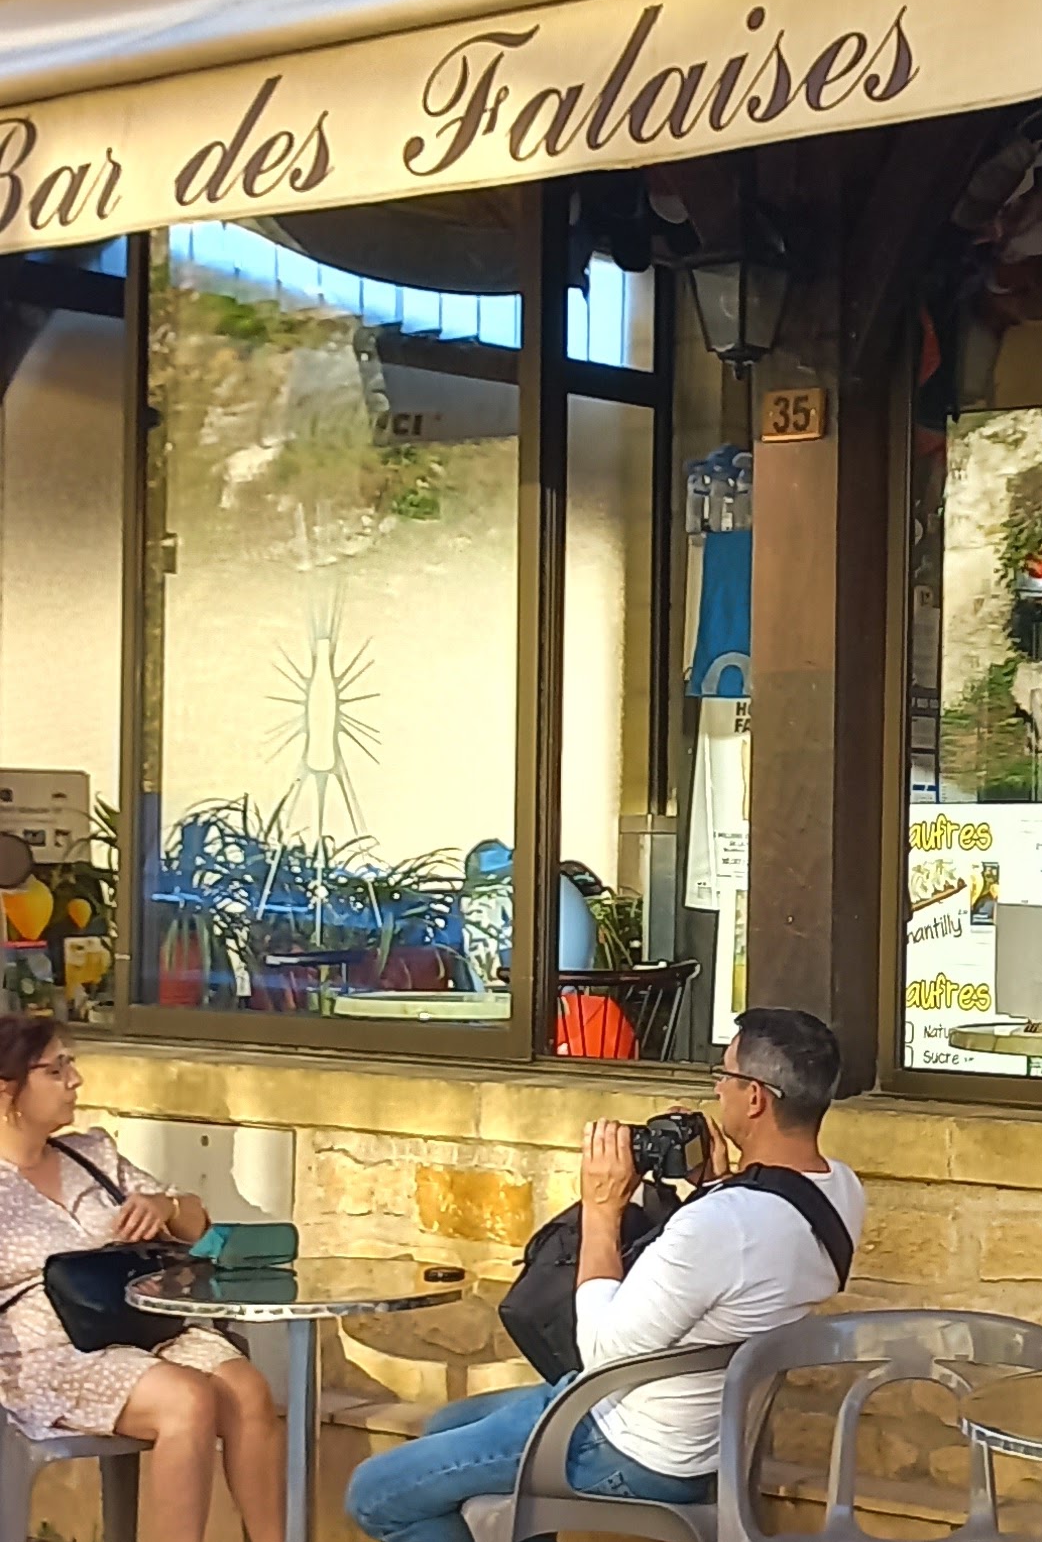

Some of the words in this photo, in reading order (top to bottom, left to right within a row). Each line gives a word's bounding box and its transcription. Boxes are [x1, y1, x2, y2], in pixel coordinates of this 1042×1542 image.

[0, 117, 122, 231] Bar
[175, 74, 334, 206] des
[403, 4, 920, 176] Falaises
[773, 395, 811, 434] 35
[736, 701, 751, 716] H
[923, 1050, 960, 1065] Sucre
